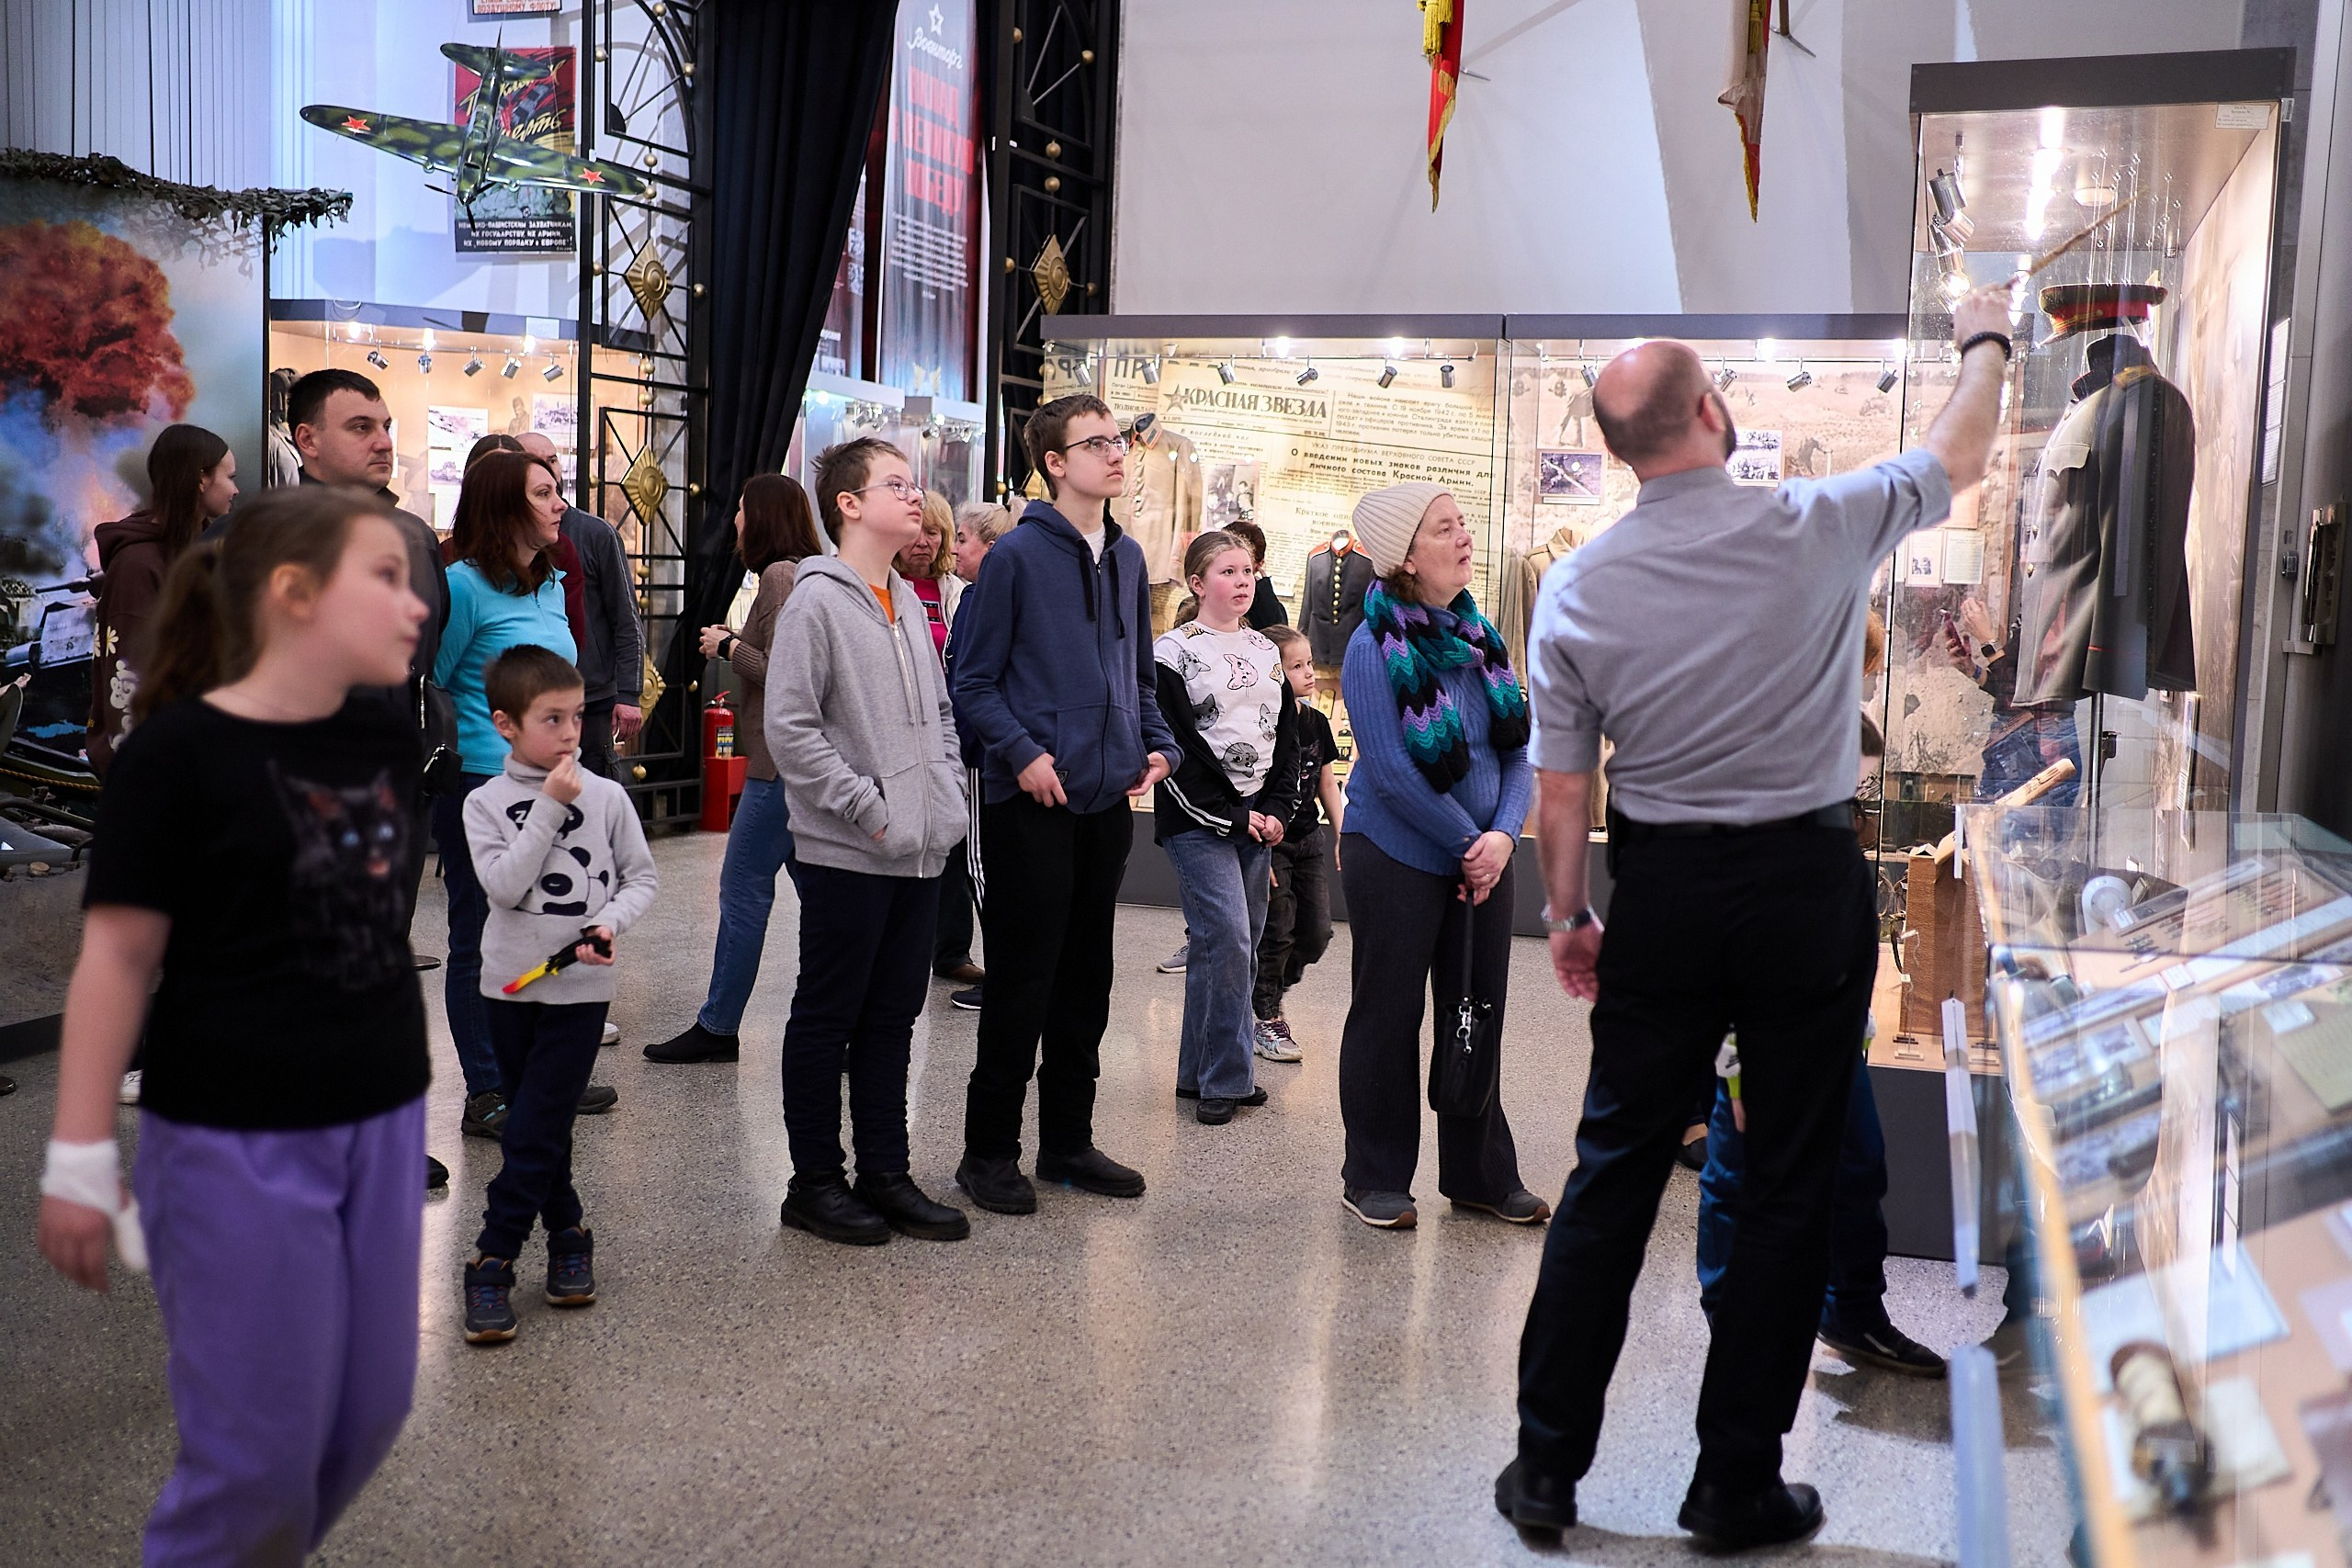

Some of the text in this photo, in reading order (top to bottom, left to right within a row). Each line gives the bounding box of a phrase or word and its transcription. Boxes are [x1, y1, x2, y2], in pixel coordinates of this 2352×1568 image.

[1183, 388, 1328, 419] КРАСНАЯ ЗВЕЗДА
[1291, 448, 1298, 457] О
[1304, 452, 1348, 462] введении
[1352, 458, 1383, 467] новых
[1388, 461, 1420, 470] знаков
[1426, 466, 1471, 476] различия
[1312, 442, 1329, 450] УКАЗ
[1332, 445, 1378, 455] ПРЕЗИДИУМА
[1381, 450, 1425, 460] ВЕРХОВНОГО
[1428, 455, 1454, 463] СОВЕТА
[1308, 463, 1474, 487] личного состава Красной Армии.
[1295, 507, 1329, 518] Краткое
